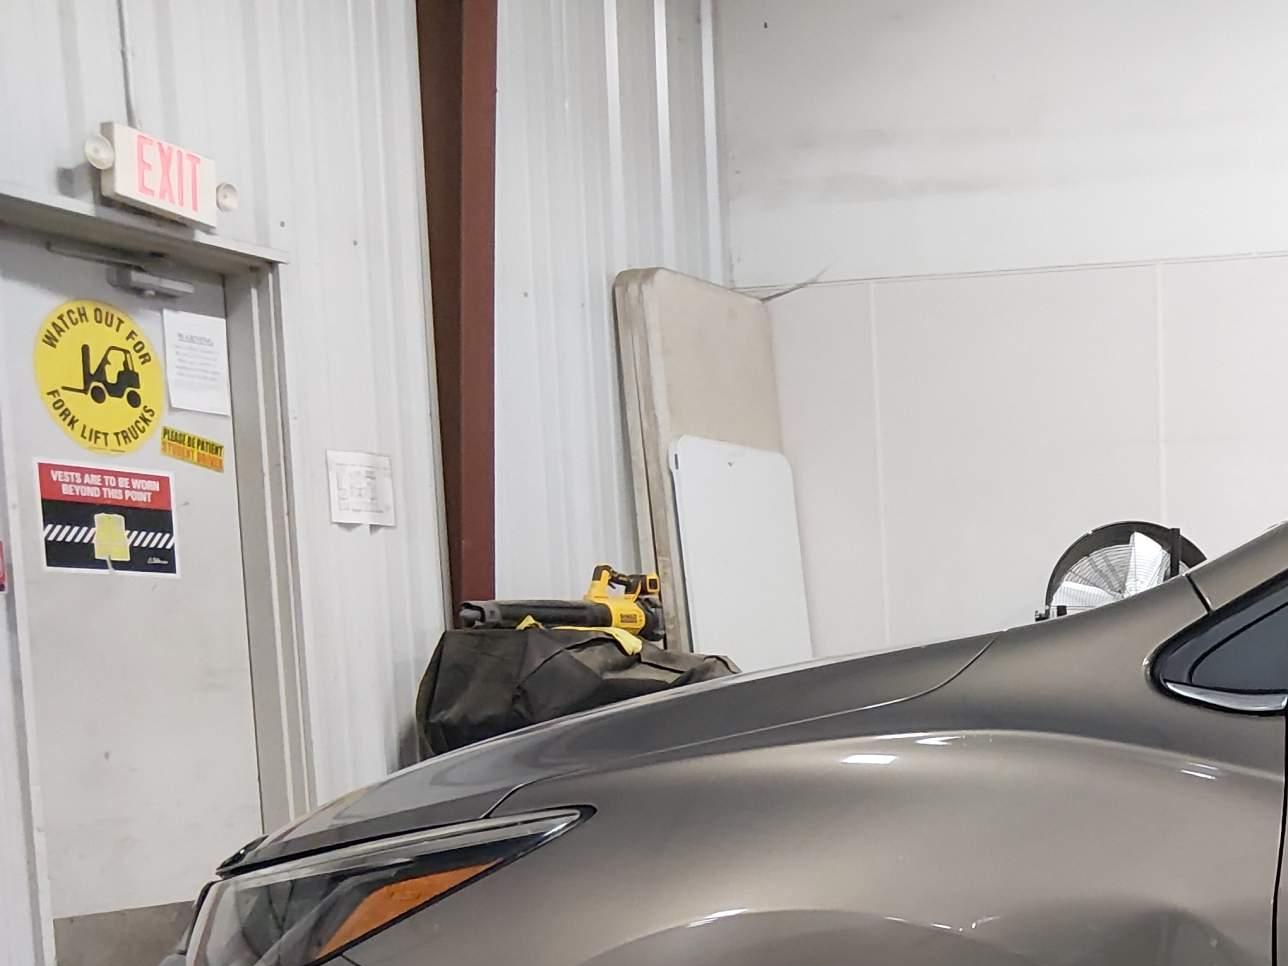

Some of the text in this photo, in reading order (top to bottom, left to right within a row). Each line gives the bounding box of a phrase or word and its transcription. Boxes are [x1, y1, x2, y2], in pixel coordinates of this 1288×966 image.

[137, 134, 201, 212] EXIT
[42, 306, 89, 349] WATCH
[94, 307, 125, 333] OUT
[125, 330, 152, 365] FOR
[46, 389, 155, 447] FORK LIFT TRUCKS
[163, 427, 225, 457] PLEASE BE PATIENT
[50, 469, 160, 491] VESTS ARE TO BE WORN
[62, 484, 153, 502] BEYOND THIS POINT
